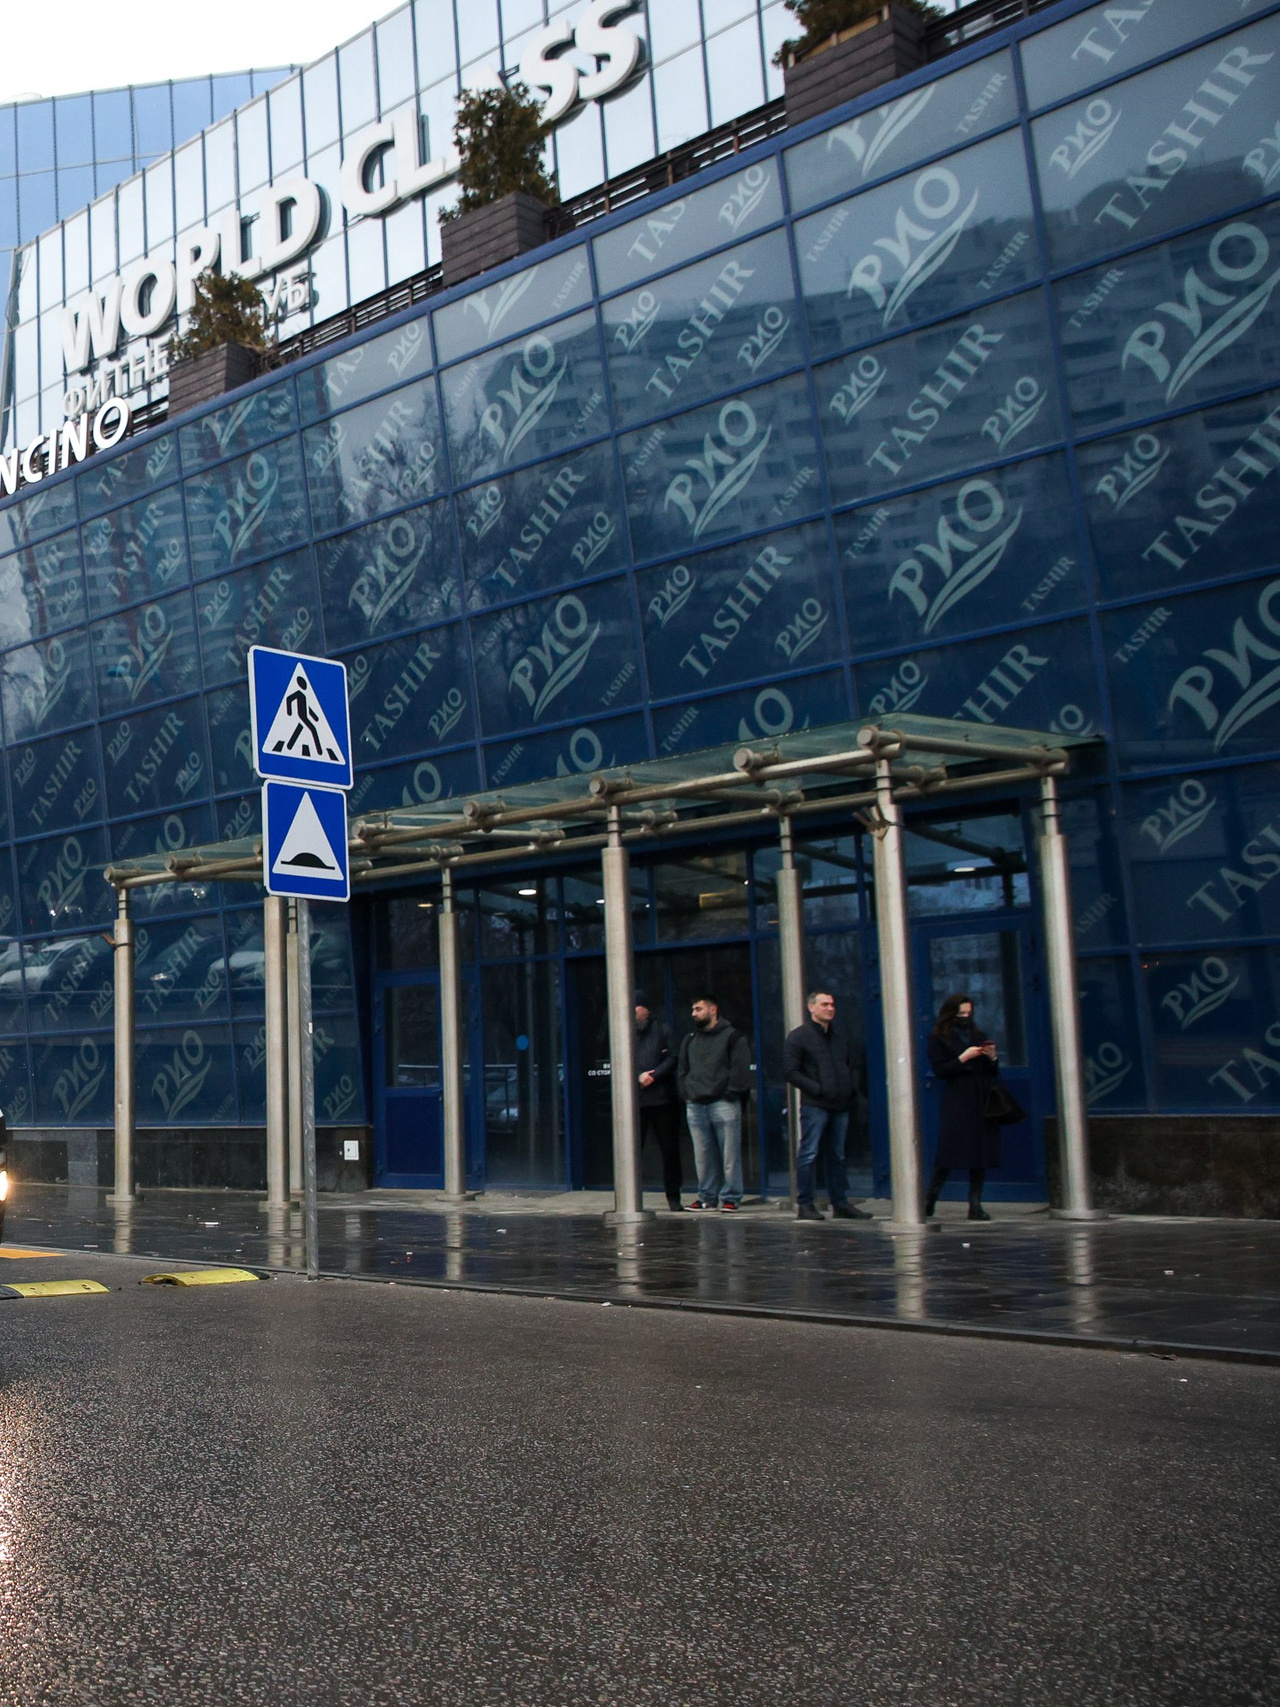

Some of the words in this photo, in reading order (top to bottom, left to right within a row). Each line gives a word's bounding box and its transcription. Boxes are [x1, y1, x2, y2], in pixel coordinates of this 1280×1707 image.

[954, 73, 1007, 134] TASHIR
[1048, 99, 1112, 173] РИО
[1093, 45, 1276, 232] TASHIR
[58, 178, 324, 376] WORLD
[340, 0, 640, 216] CLSS
[719, 165, 765, 228] РИО
[805, 207, 850, 265] TASHIR
[848, 166, 961, 308] РИО
[977, 229, 1030, 292] TASHIR
[614, 290, 656, 349] РИО
[644, 259, 756, 400] TASHIR
[1067, 265, 1124, 330] TASHIR
[1123, 222, 1270, 384] РИО
[387, 321, 419, 371] РИО
[737, 306, 784, 369] РИО
[64, 334, 176, 420] ФИТНЕ
[479, 334, 556, 450] РИО
[829, 354, 880, 418] РИО
[866, 323, 1005, 477] TASHIR
[981, 376, 1039, 444] РИО
[664, 401, 756, 524] РИО
[772, 465, 816, 517] TASHIR
[1094, 433, 1161, 503] РИО
[1141, 405, 1280, 572] TASHI
[212, 452, 270, 550] РИО
[465, 485, 502, 538] РИО
[492, 465, 586, 590] TASHIR
[845, 507, 891, 561] TASHIR
[348, 517, 416, 620] РИО
[570, 511, 611, 566] РИО
[888, 479, 1005, 617] РИО
[225, 565, 293, 668] TASHIR
[648, 564, 692, 622] РИО
[679, 546, 795, 680] TASHIR
[1021, 556, 1077, 613] TASHIR
[116, 604, 166, 692] РИО
[508, 594, 588, 707] РИО
[774, 598, 822, 657] РИО
[1113, 606, 1174, 664] TASHIR
[360, 641, 442, 752] TASHIR
[428, 687, 462, 736] РИО
[600, 661, 637, 706] TASHIR
[106, 721, 130, 761] РИО
[124, 712, 187, 803] TASHIR
[662, 707, 700, 753] TASHIR
[13, 748, 35, 785] РИО
[29, 741, 84, 827] TASHIR
[73, 778, 96, 817] РИО
[174, 751, 201, 794] РИО
[492, 744, 524, 786] TASHIR
[223, 800, 251, 839] РИО
[1139, 778, 1208, 847] РИО
[37, 836, 83, 912] РИО
[90, 981, 113, 1018] РИО
[142, 926, 205, 1016] TASHIR
[193, 969, 220, 1008] РИО
[1161, 956, 1230, 1022] РИО
[53, 1037, 100, 1114] РИО
[151, 1029, 204, 1112] РИО
[322, 1074, 353, 1116] РИО
